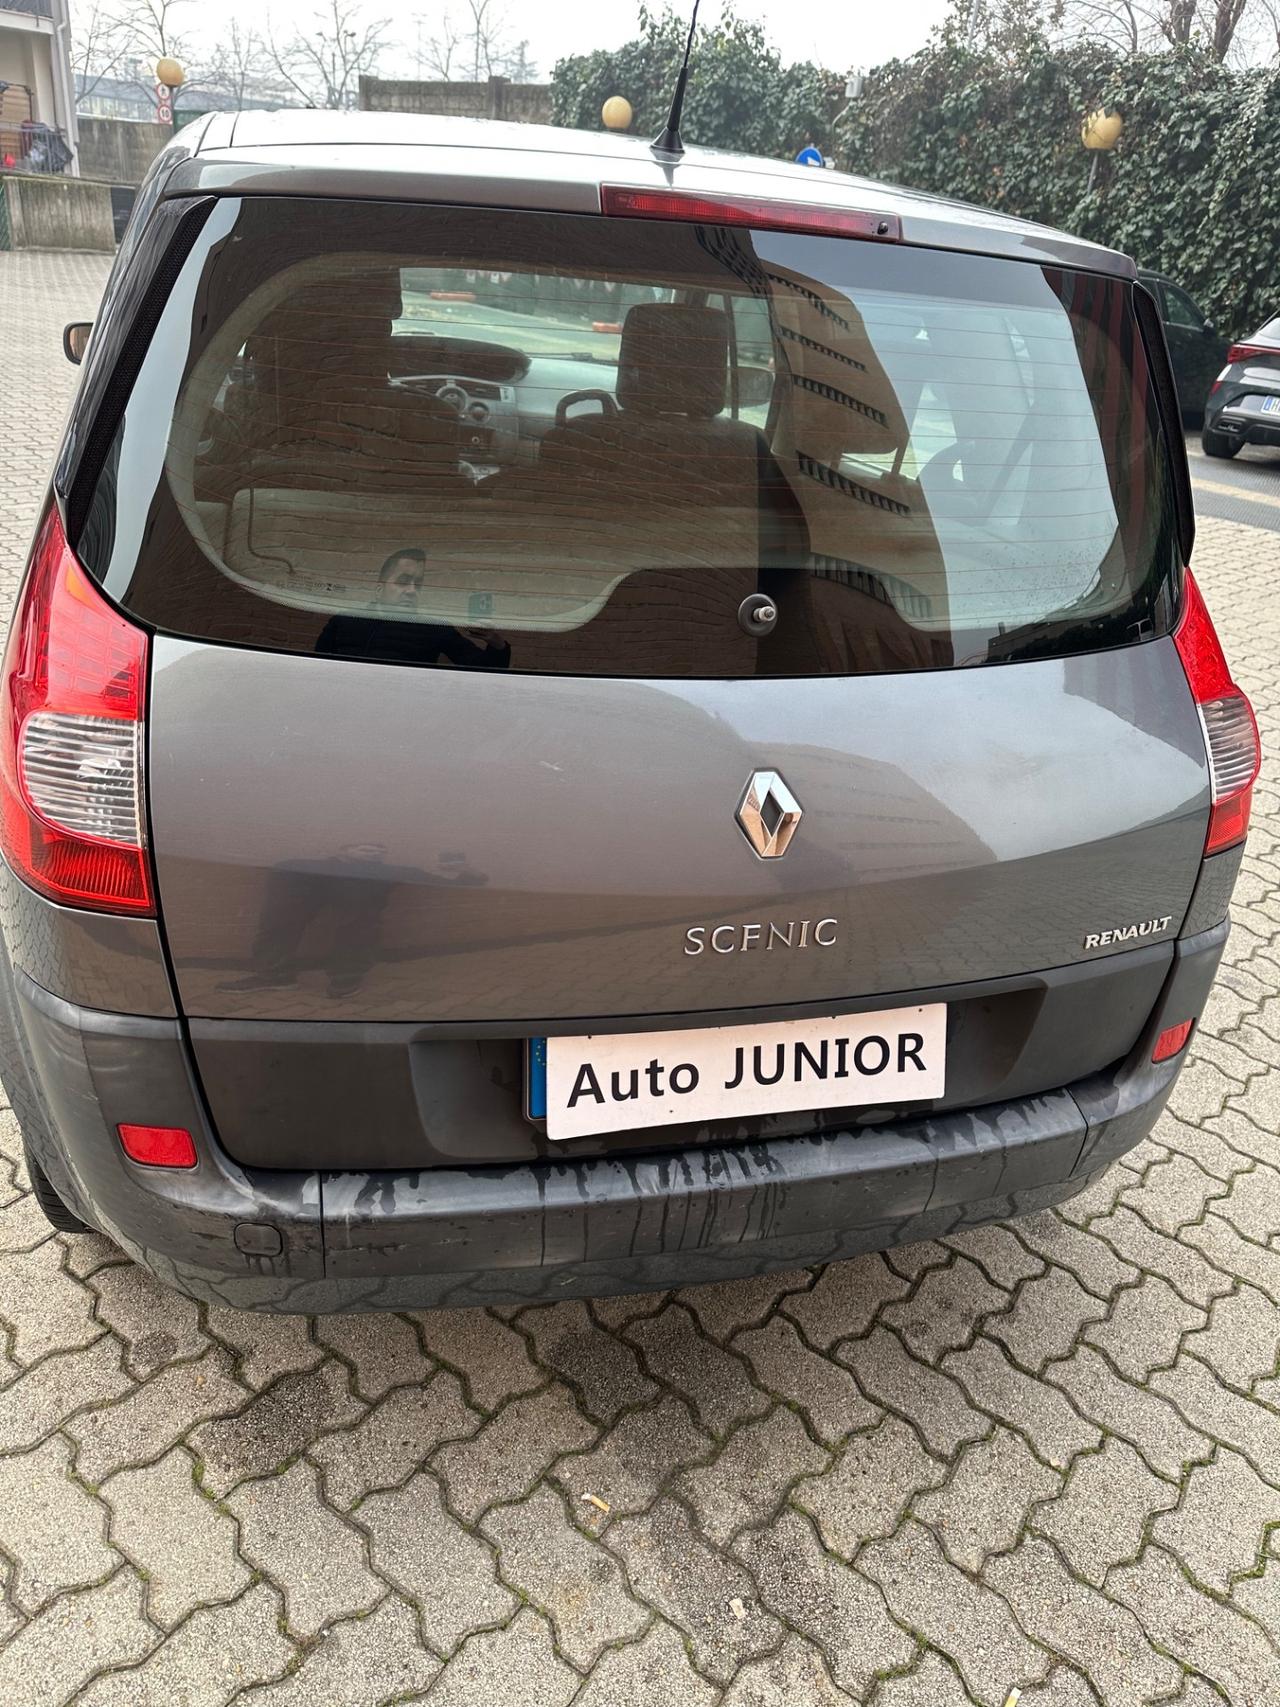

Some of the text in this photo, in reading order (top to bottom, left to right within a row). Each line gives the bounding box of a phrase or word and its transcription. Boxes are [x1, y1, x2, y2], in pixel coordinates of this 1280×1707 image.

[1084, 915, 1172, 949] RENAULT
[567, 1032, 927, 1108] Auto JUNIOR
